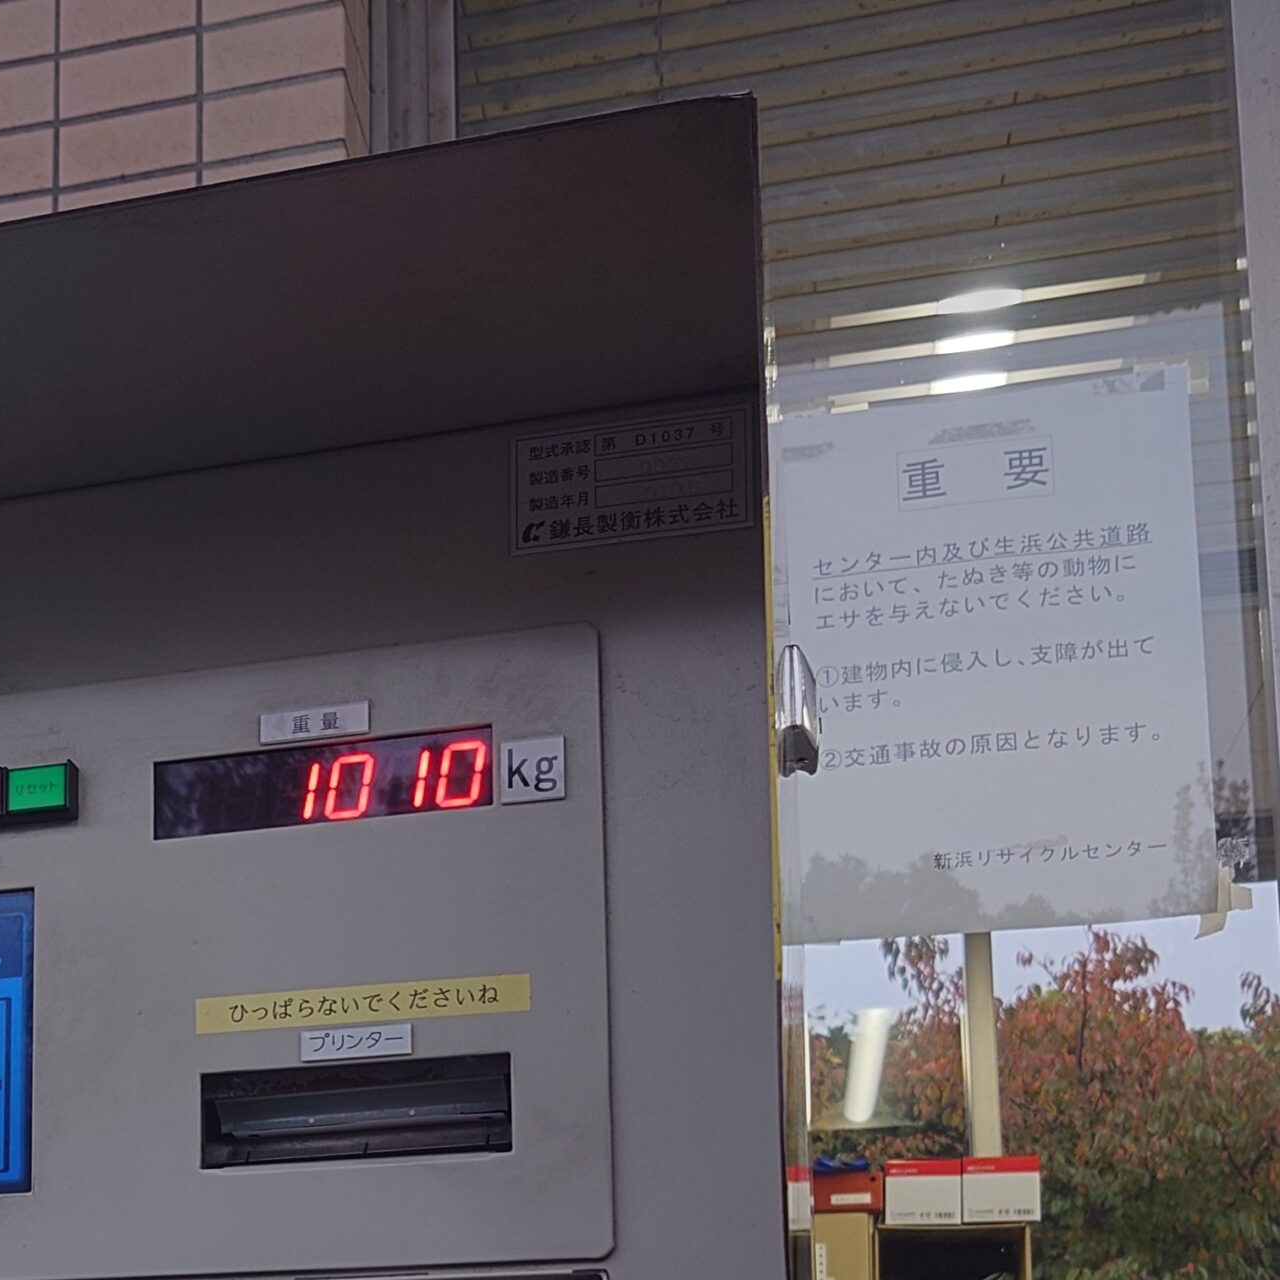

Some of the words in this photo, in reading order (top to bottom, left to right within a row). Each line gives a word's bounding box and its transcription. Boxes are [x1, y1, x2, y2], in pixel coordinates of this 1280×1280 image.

[528, 439, 591, 461] 型式承認
[601, 437, 616, 451] 第
[635, 427, 695, 446] D1037
[528, 464, 590, 486] 製造番号
[528, 491, 589, 512] 製造年月
[549, 497, 738, 540] 鎌長製衡株式会社
[813, 522, 1151, 577] センター内及び生浜公共道路
[814, 553, 1137, 604] において、たぬき等の動物に
[815, 582, 1126, 630] エサを与えないでください。
[819, 690, 902, 714] います。
[292, 711, 339, 734] 重量
[302, 740, 487, 820] 1010
[506, 748, 559, 792] kg
[15, 782, 57, 796] リセット
[933, 841, 1168, 869] 新浜リサイクルセンター
[229, 983, 500, 1023] ひっぱらないでくださいね
[308, 1031, 404, 1052] プリンター
